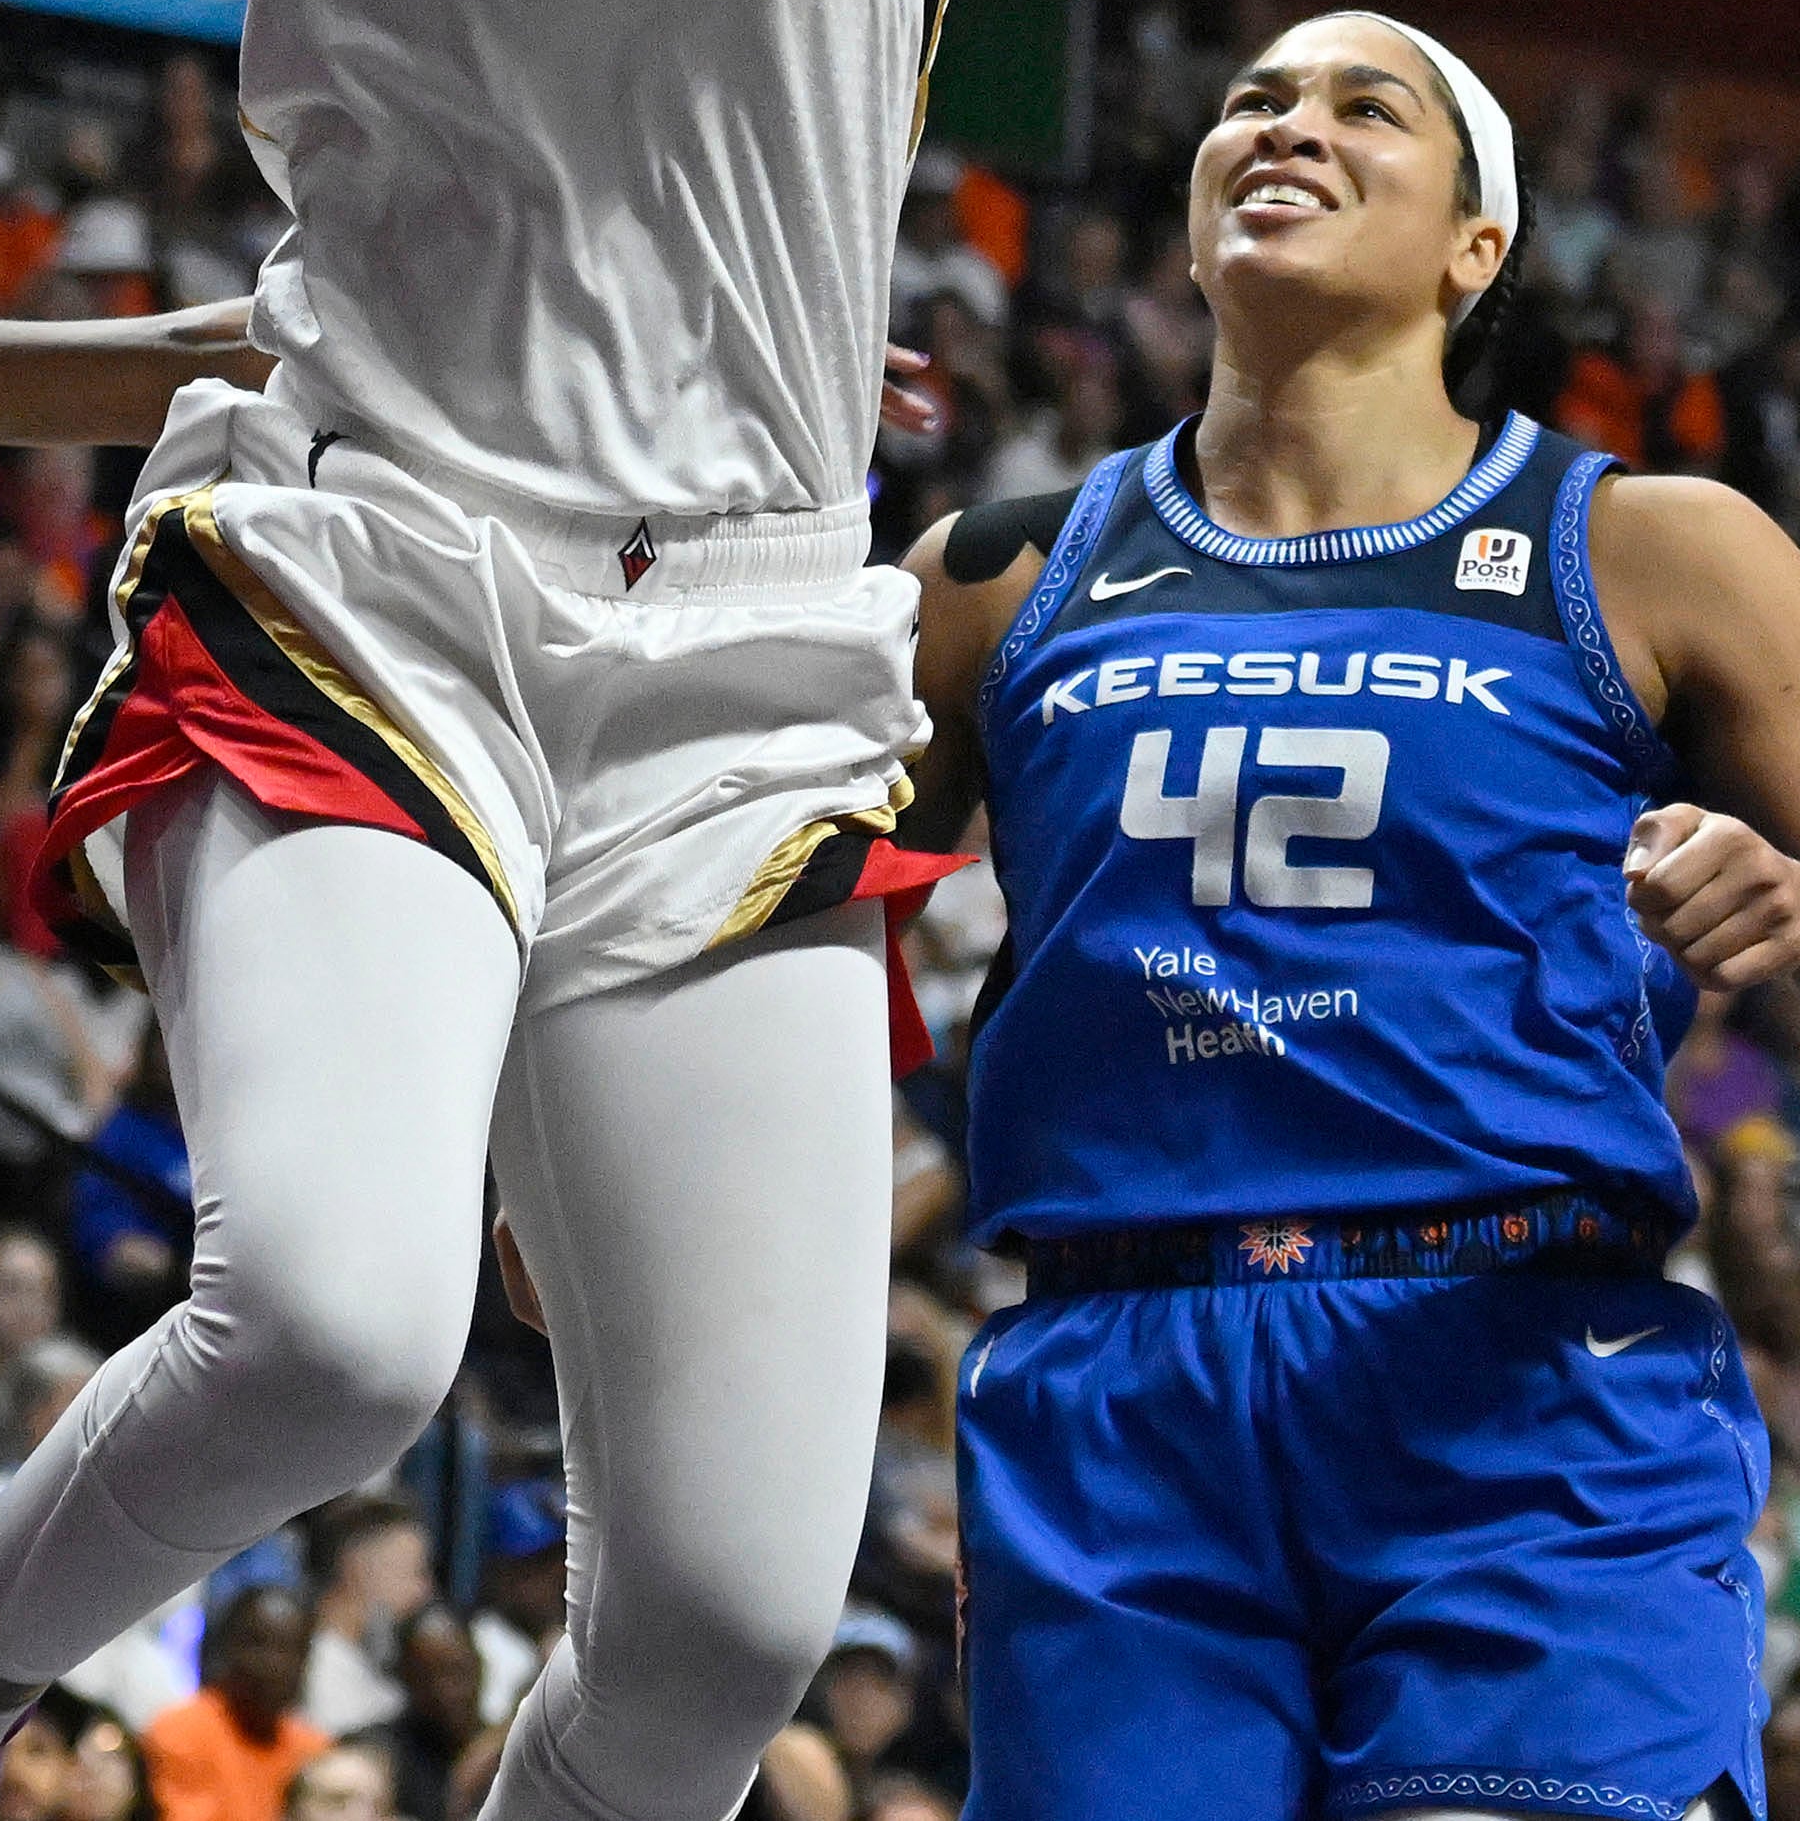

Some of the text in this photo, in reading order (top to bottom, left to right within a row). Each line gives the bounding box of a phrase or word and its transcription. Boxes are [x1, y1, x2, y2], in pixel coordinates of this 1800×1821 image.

[1460, 560, 1521, 582] Post
[1042, 652, 1513, 726] KEESUSK
[1120, 726, 1390, 908] 42
[1133, 946, 1217, 981] Yale
